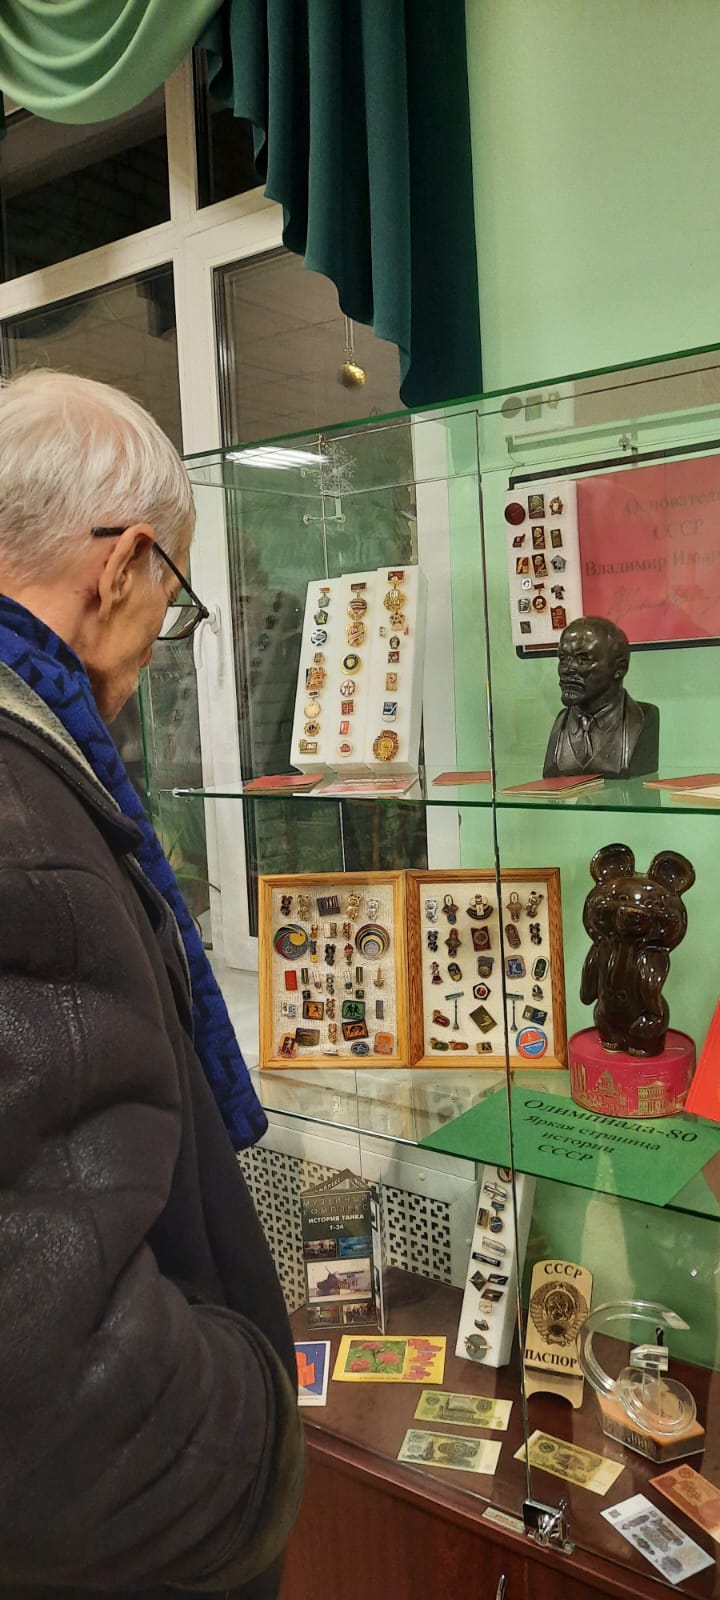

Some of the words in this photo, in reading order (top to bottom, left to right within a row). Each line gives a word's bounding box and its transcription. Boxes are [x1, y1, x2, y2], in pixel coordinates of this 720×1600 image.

[652, 519, 703, 539] СССР
[585, 557, 667, 577] Владимир
[524, 1099, 698, 1143] Олимпиада-80
[524, 1115, 574, 1132] Яркая
[578, 1127, 661, 1151] страница
[541, 1131, 615, 1154] истории
[537, 1144, 593, 1162] СССР
[308, 1215, 340, 1224] ИСТОРИЯ
[341, 1213, 365, 1221] ТАНКА
[544, 1263, 583, 1279] СССР
[525, 1349, 577, 1368] ПАСПОР
